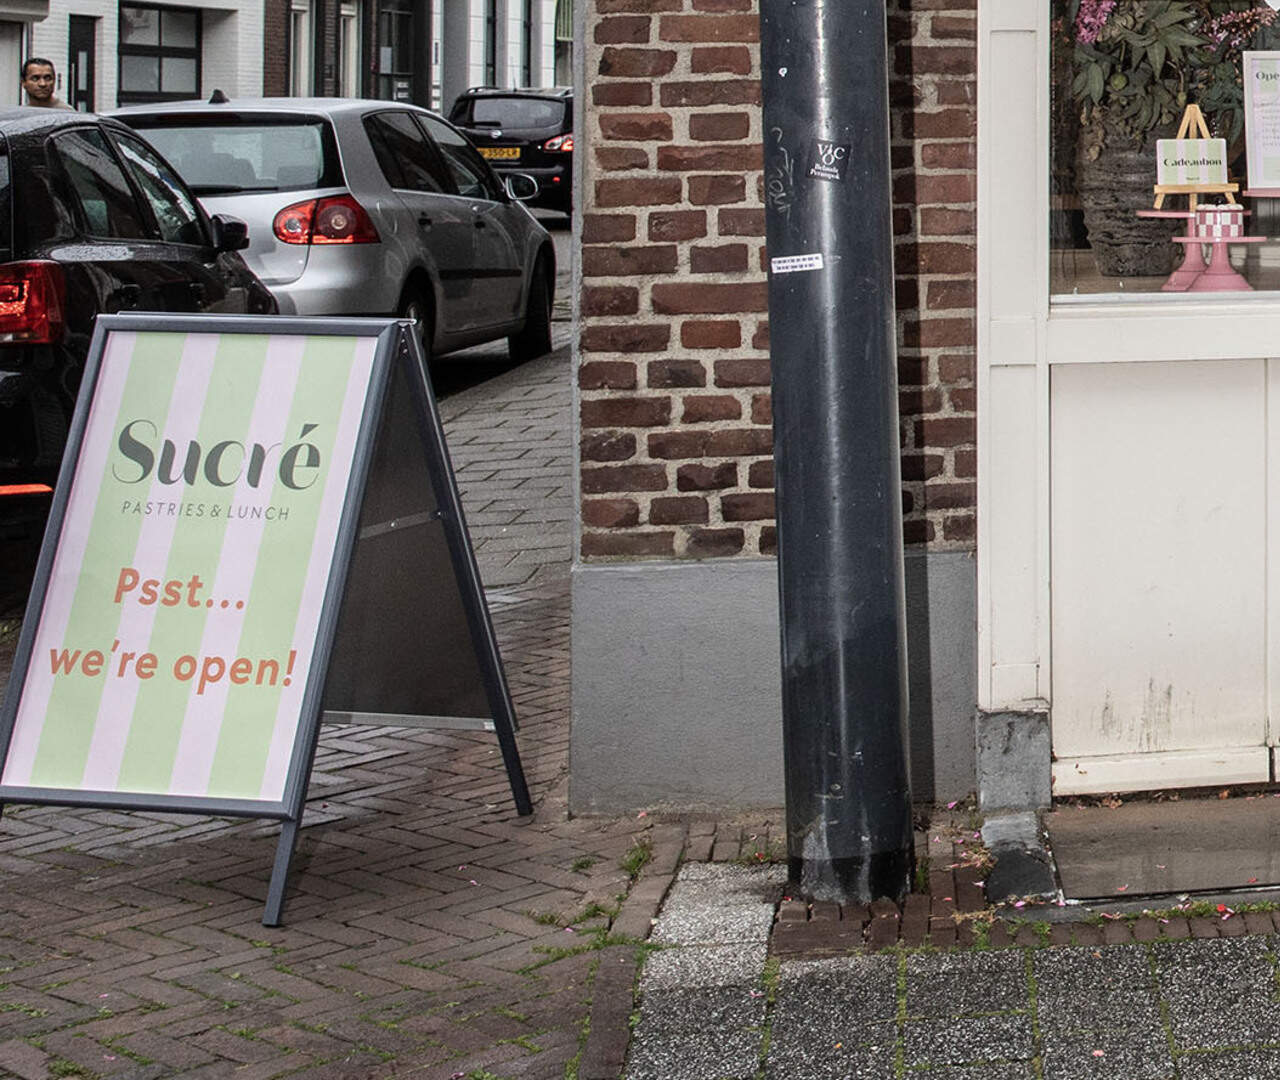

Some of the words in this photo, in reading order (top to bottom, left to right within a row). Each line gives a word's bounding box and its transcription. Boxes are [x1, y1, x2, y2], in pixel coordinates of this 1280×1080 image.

[1163, 157, 1222, 167] Cadeaubon
[112, 418, 320, 491] Sucré
[122, 499, 206, 518] PASTRIES
[209, 504, 222, 518] &
[227, 504, 291, 521] LUNCH
[113, 567, 245, 610] Psst...
[49, 639, 159, 680] we're
[172, 650, 298, 696] open!
